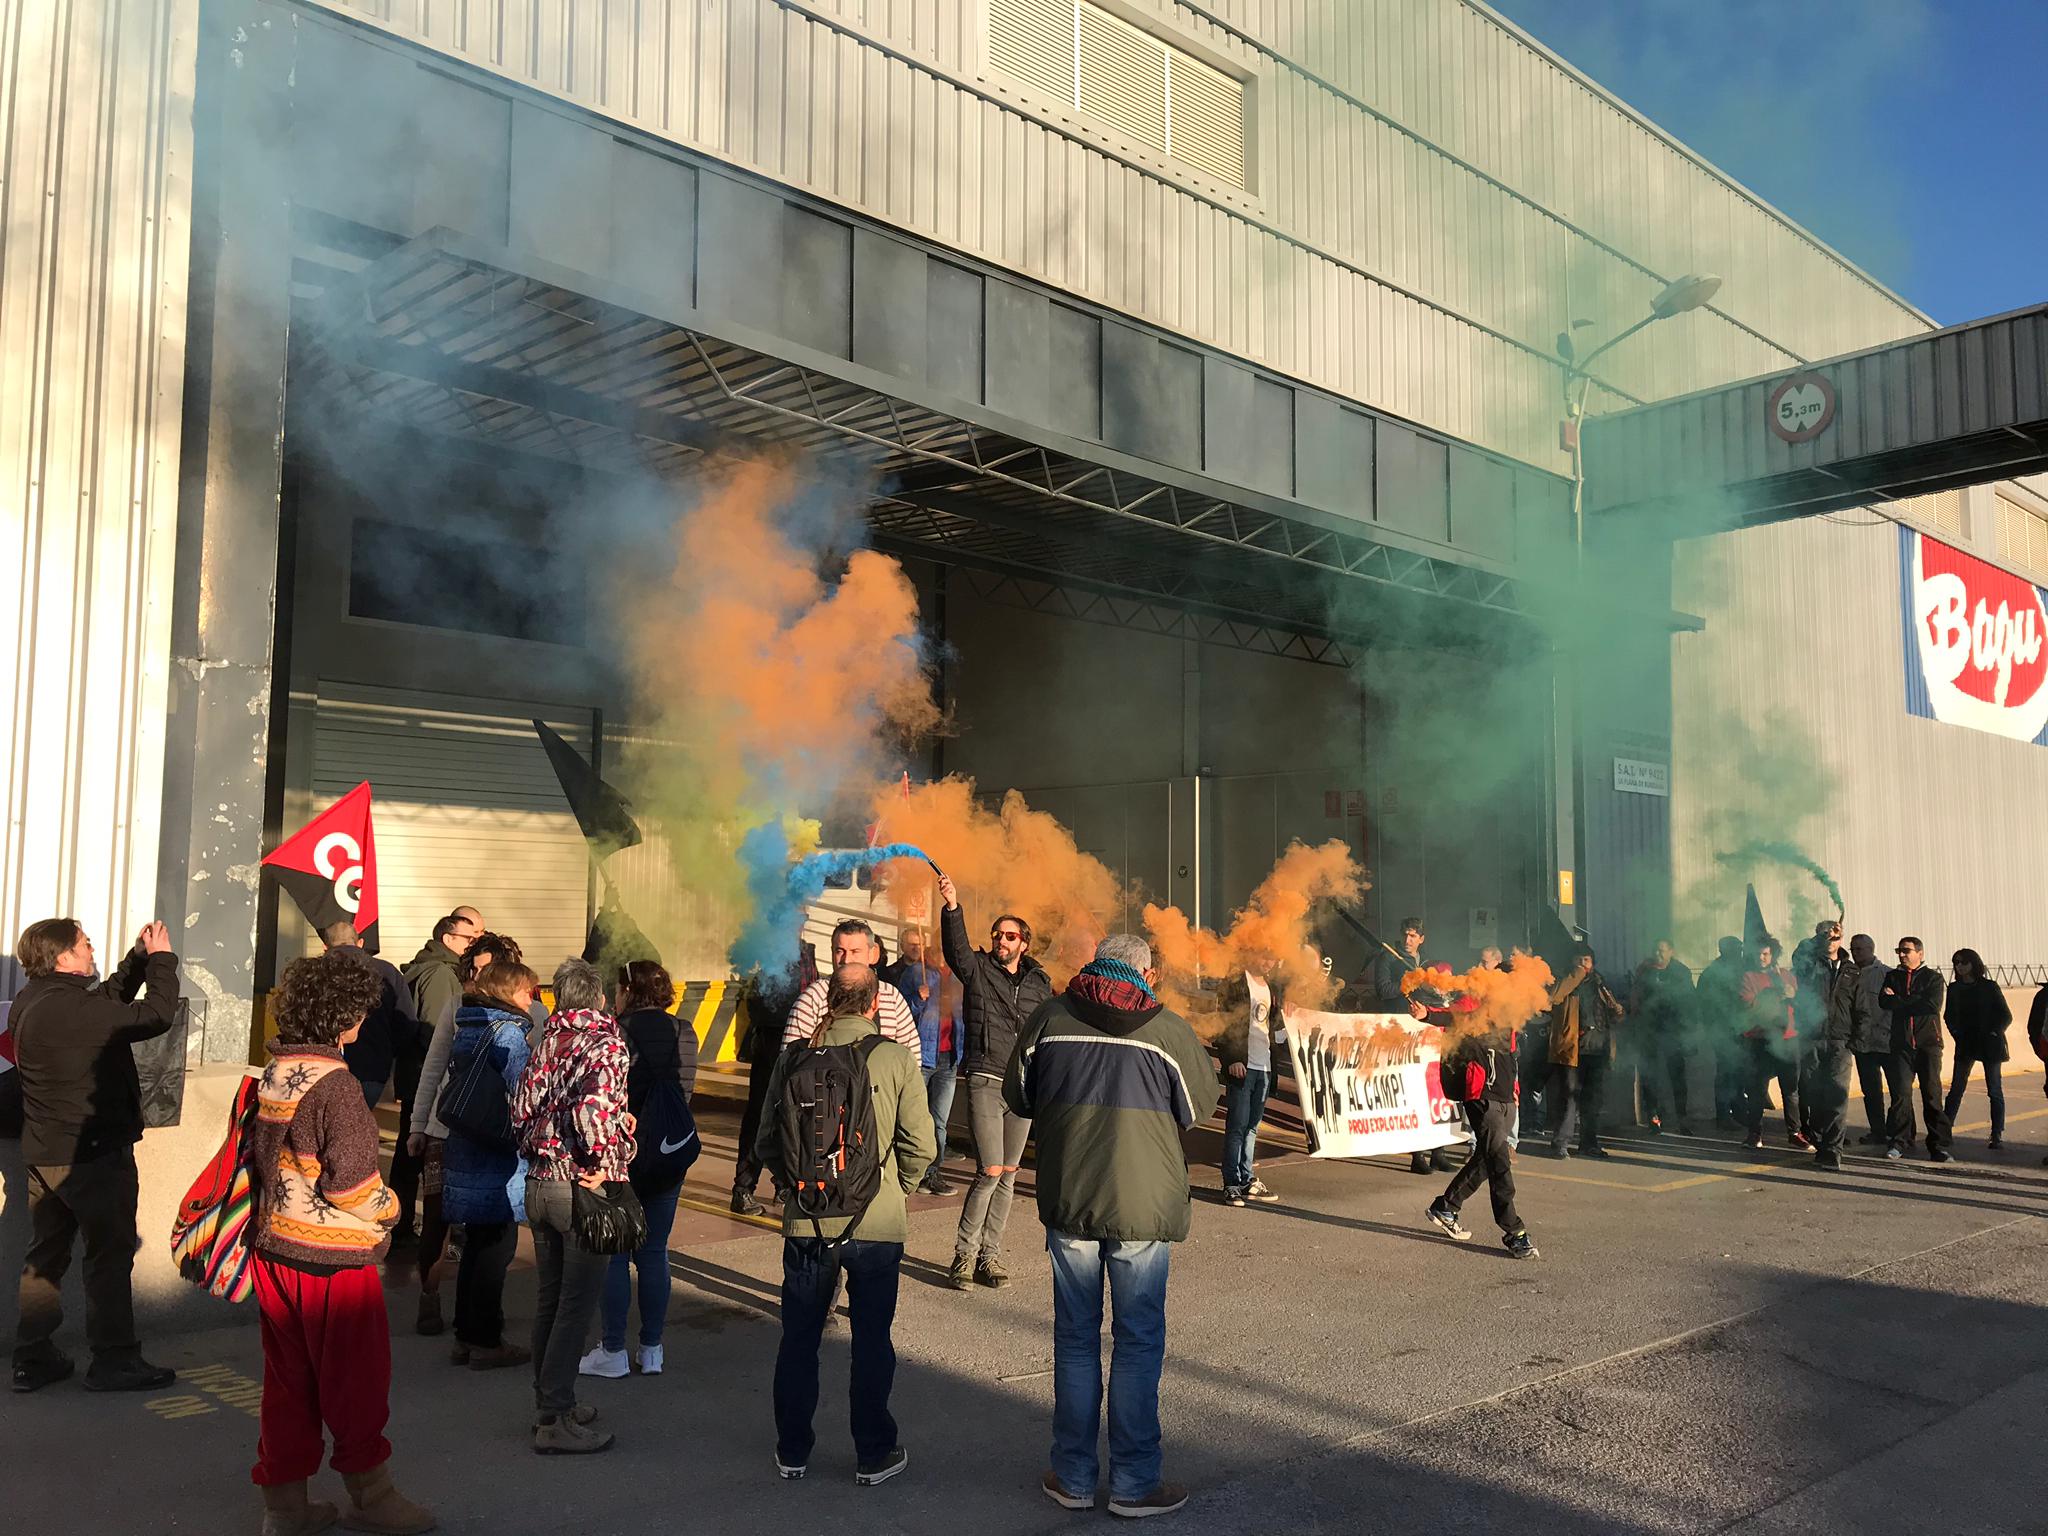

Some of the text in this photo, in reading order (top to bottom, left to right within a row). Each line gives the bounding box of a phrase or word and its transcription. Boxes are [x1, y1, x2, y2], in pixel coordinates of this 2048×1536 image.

[1918, 573, 2042, 707] Bagu
[313, 832, 363, 913] CG
[1347, 1073, 1407, 1111] AL CAMP!
[1430, 1098, 1464, 1122] CGT
[1348, 1109, 1419, 1135] PROU EXPLOTACIÓ
